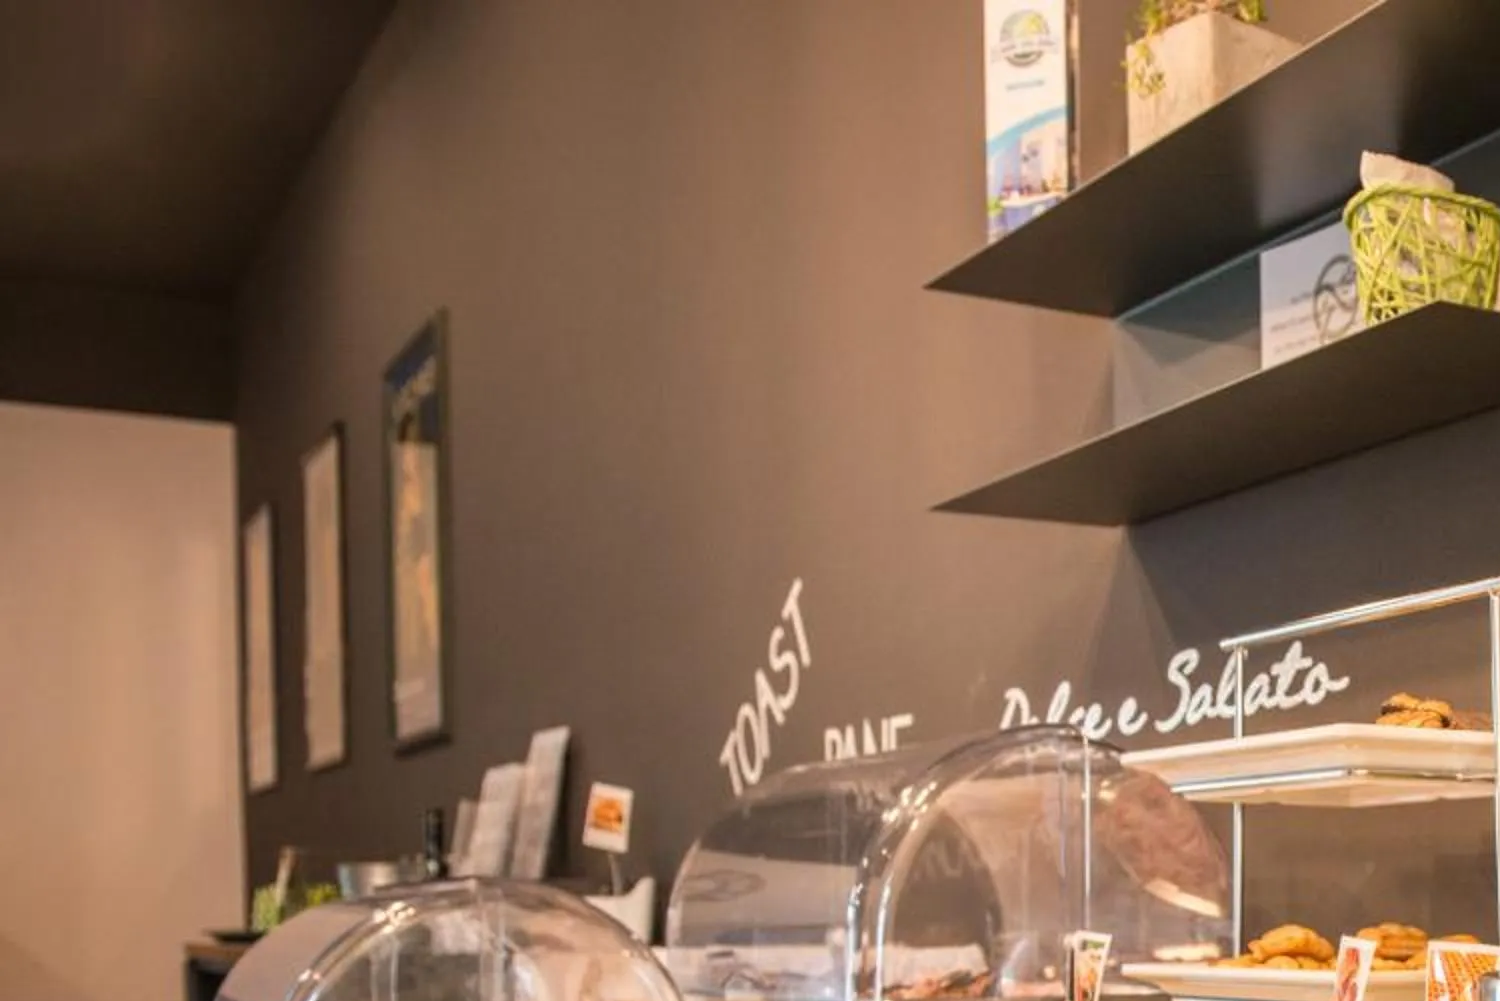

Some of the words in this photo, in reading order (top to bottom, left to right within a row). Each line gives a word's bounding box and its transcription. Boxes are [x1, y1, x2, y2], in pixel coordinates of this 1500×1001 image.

[719, 577, 811, 797] TOAST
[1117, 696, 1148, 736] e
[1154, 640, 1350, 733] Salato
